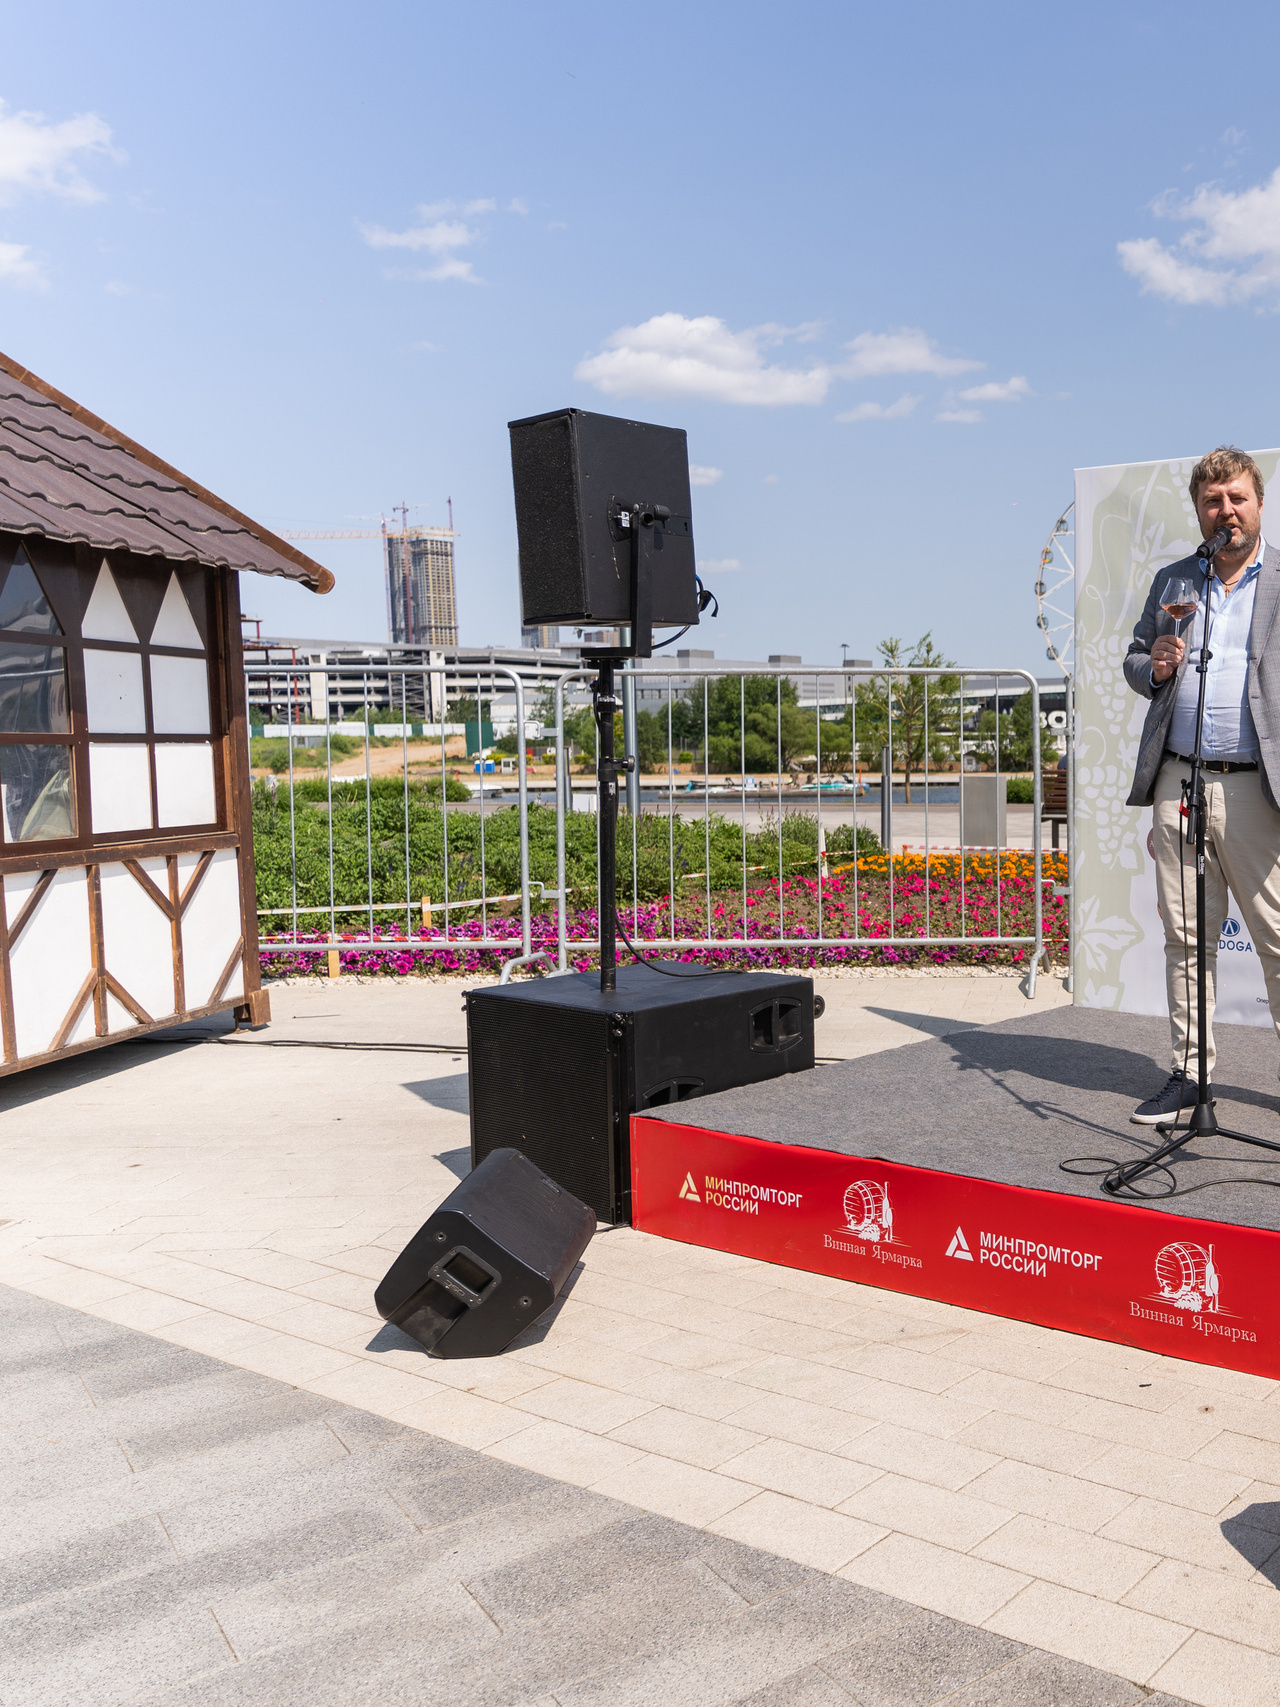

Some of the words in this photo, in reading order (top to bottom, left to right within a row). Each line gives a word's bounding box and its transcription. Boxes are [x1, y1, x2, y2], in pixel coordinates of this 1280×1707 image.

[705, 1175, 803, 1208] МИНПРОМТОРГ
[705, 1191, 759, 1215] РОССИИ
[824, 1234, 866, 1256] Винная
[872, 1246, 923, 1269] Ярмарка
[980, 1231, 1103, 1271] МИНПРОМТОРГ
[980, 1249, 1046, 1278] РОССИИ
[1129, 1301, 1184, 1327] Винная
[1191, 1314, 1258, 1343] Ярмарка
